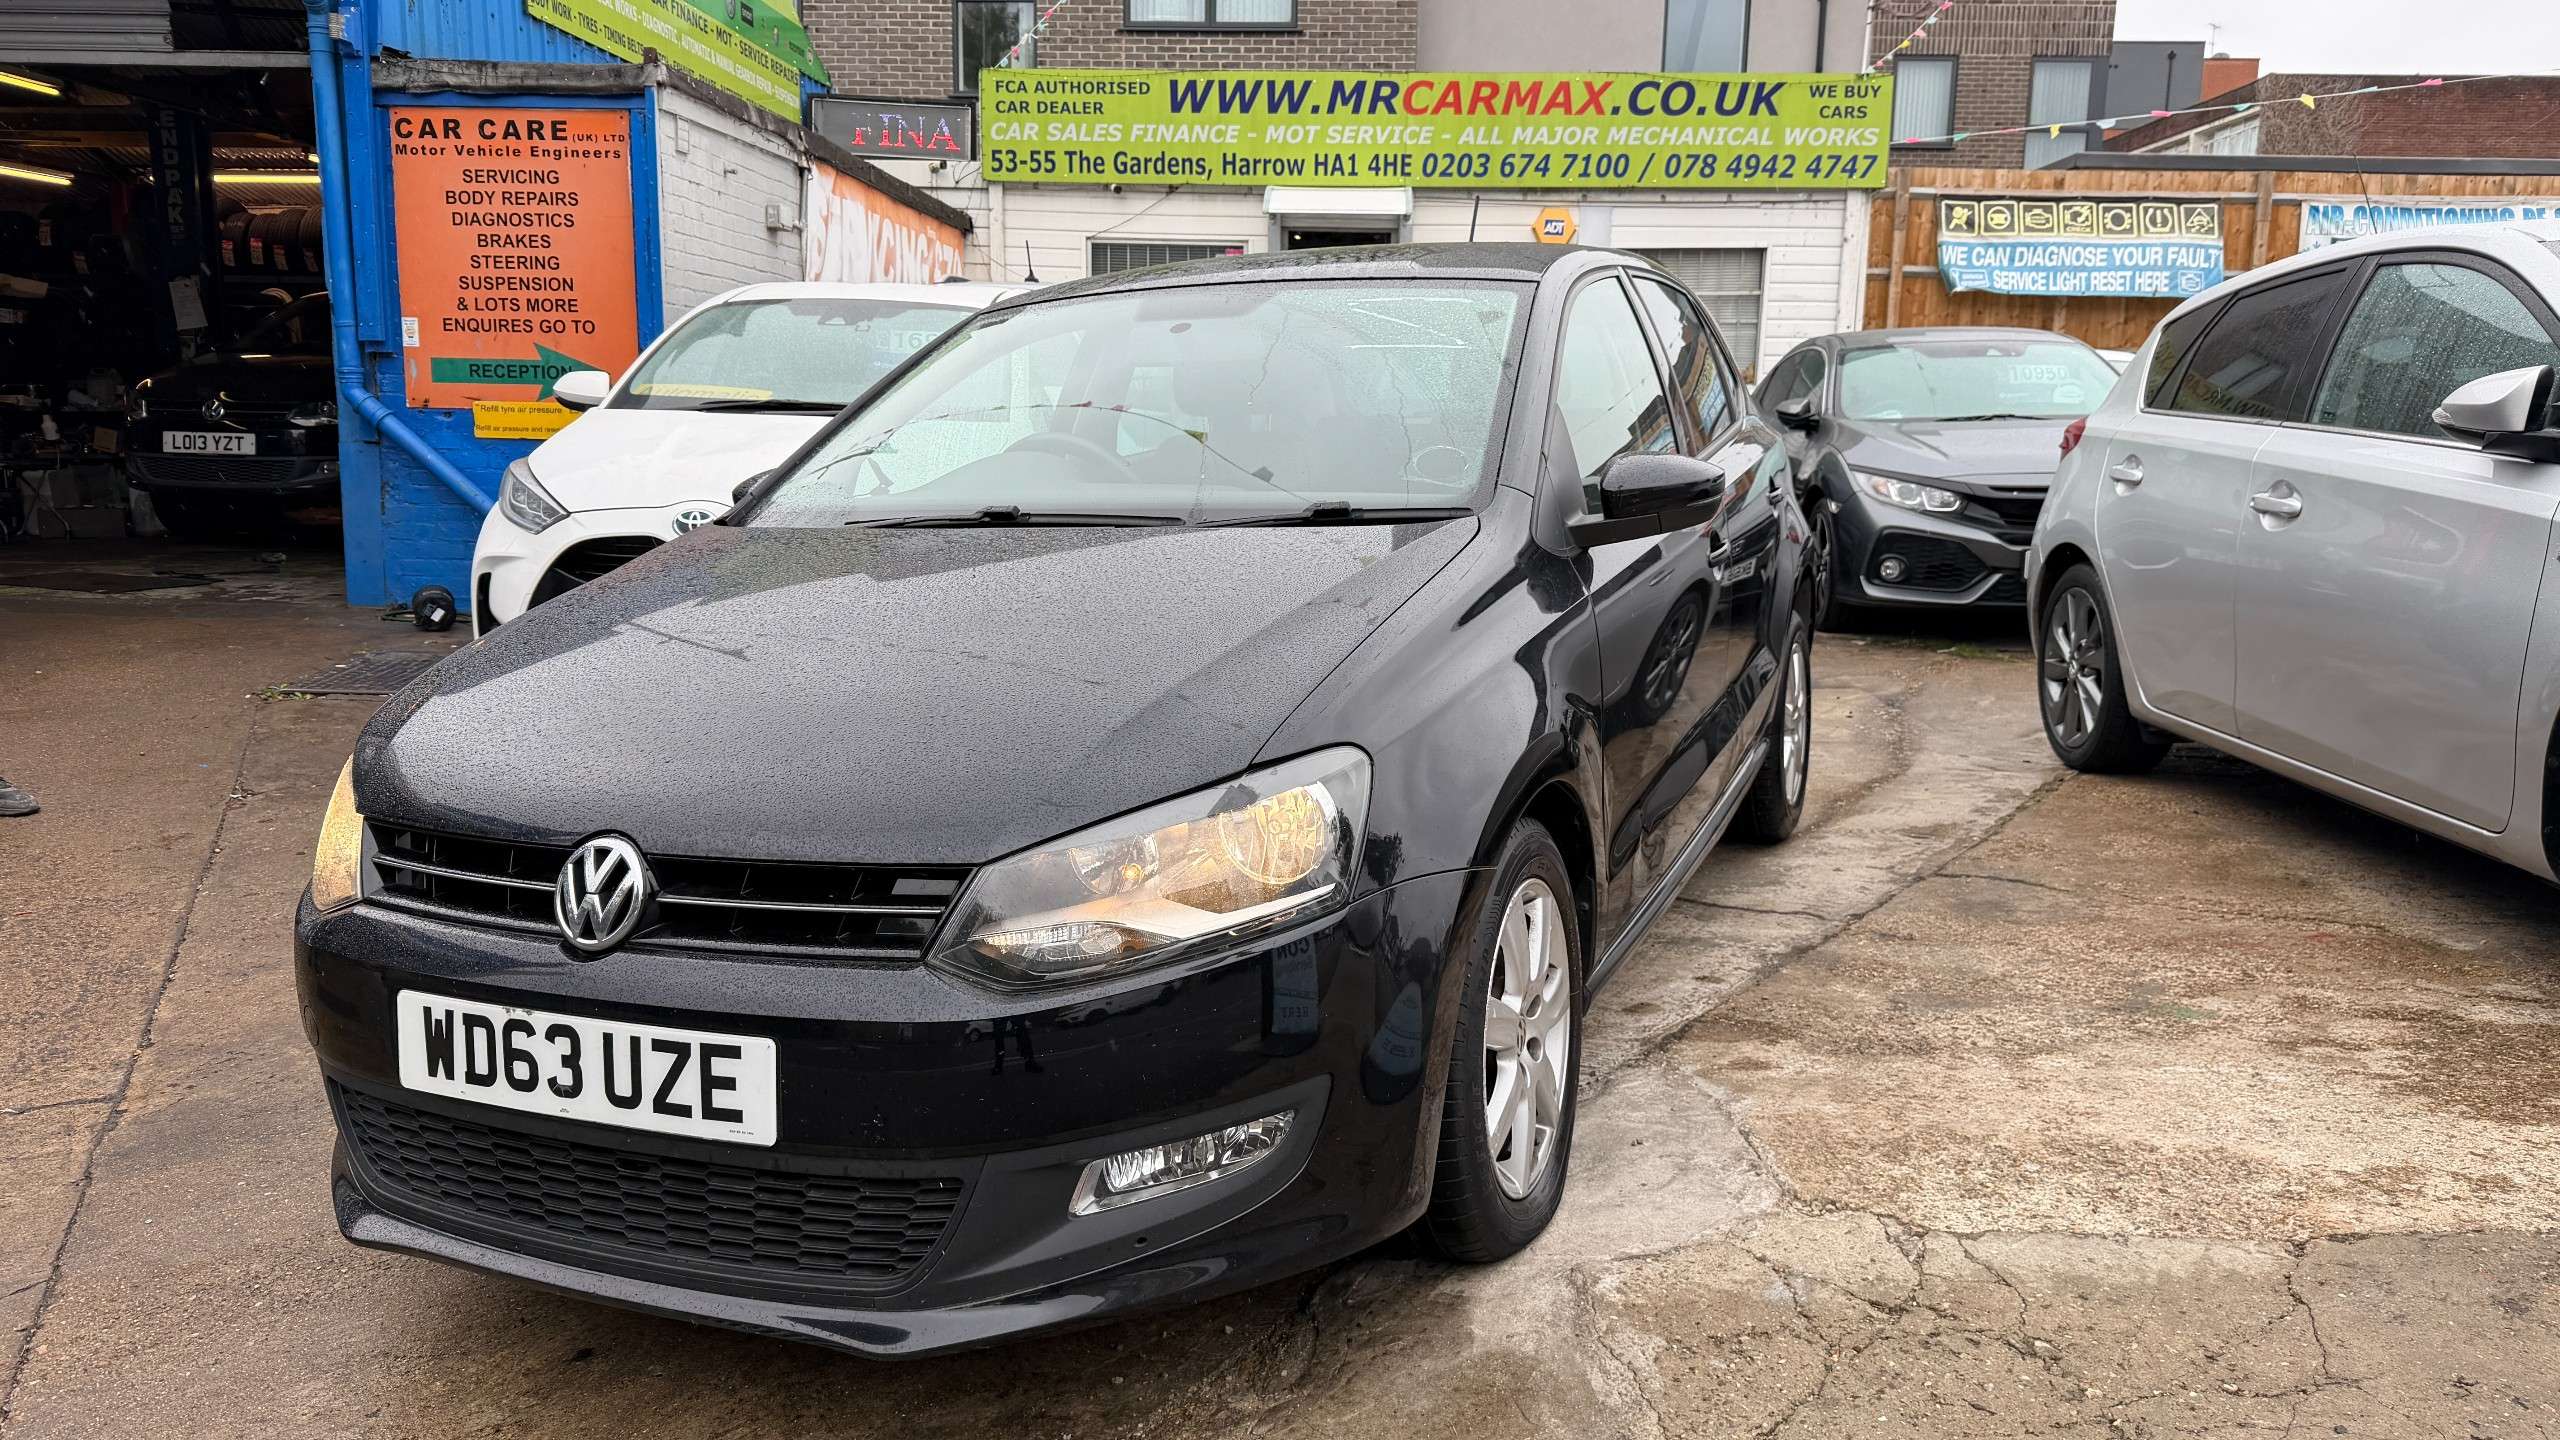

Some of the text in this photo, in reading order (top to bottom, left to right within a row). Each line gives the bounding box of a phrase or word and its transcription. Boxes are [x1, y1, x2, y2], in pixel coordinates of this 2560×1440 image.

[551, 0, 573, 22] WORK
[578, 11, 598, 34] TYRES
[603, 24, 627, 47] TIMING
[670, 0, 709, 34] FINANCE
[716, 25, 732, 47] MOT
[739, 40, 769, 70] SERVICE
[771, 58, 800, 86] REPAIRS
[995, 80, 1150, 95] FCA AUTHORISED
[1809, 84, 1881, 98] WE BUY
[1169, 78, 1787, 117] WWW.MRCARMAX.CO.UK
[995, 100, 1104, 115] CAR DEALER
[1819, 105, 1867, 119] CARS
[394, 117, 625, 143] CAR CARE (UK) LTD
[990, 122, 1039, 141] CAR
[1046, 122, 1122, 142] SALES
[1130, 124, 1240, 144] FINANCE
[1265, 125, 1320, 144] MOT
[1326, 125, 1434, 145] SERVICE
[1457, 126, 1504, 145] ALL
[1511, 126, 1599, 145] MAJOR
[1606, 127, 1774, 146] MECHANICAL
[1784, 127, 1880, 147] WORKS
[395, 144, 621, 160] Motor Vehicle Engineers
[991, 149, 1056, 173] 53-55
[1064, 150, 1105, 174] The
[1113, 150, 1213, 180] Gardens,
[1222, 152, 1305, 176] Harrow
[1314, 153, 1358, 177] HA1
[1368, 153, 1413, 177] 4HE
[1421, 153, 1490, 178] 0203
[1500, 153, 1551, 178] 674
[1560, 153, 1630, 178] 7100
[1664, 154, 1718, 179] 078
[1726, 154, 1797, 179] 4942
[1804, 154, 1878, 179] 4747
[462, 168, 560, 184] SERVICING
[445, 190, 579, 206] BODY REPAIRS
[452, 211, 575, 227] DIAGNOSTICS
[1544, 220, 1565, 235] ADT
[477, 233, 551, 248] BRAKES
[470, 255, 560, 270] STEERING
[1942, 245, 2222, 268] WE CAN DIAGNOSE YOUR FAULT
[459, 275, 574, 291] SUSPENSION
[1993, 270, 2050, 291] SERVICE
[2051, 271, 2088, 291] LIGHT
[2090, 271, 2132, 292] RESET
[2135, 271, 2169, 292] HERE
[457, 297, 579, 313] & LOTS MORE
[443, 317, 596, 334] ENQUIRES GO TO
[469, 363, 573, 379] RECEPTION
[480, 404, 499, 413] Refill
[529, 406, 562, 414] pressure
[172, 434, 244, 452] LO13 YZT
[422, 1005, 743, 1124] WD63 UZE
